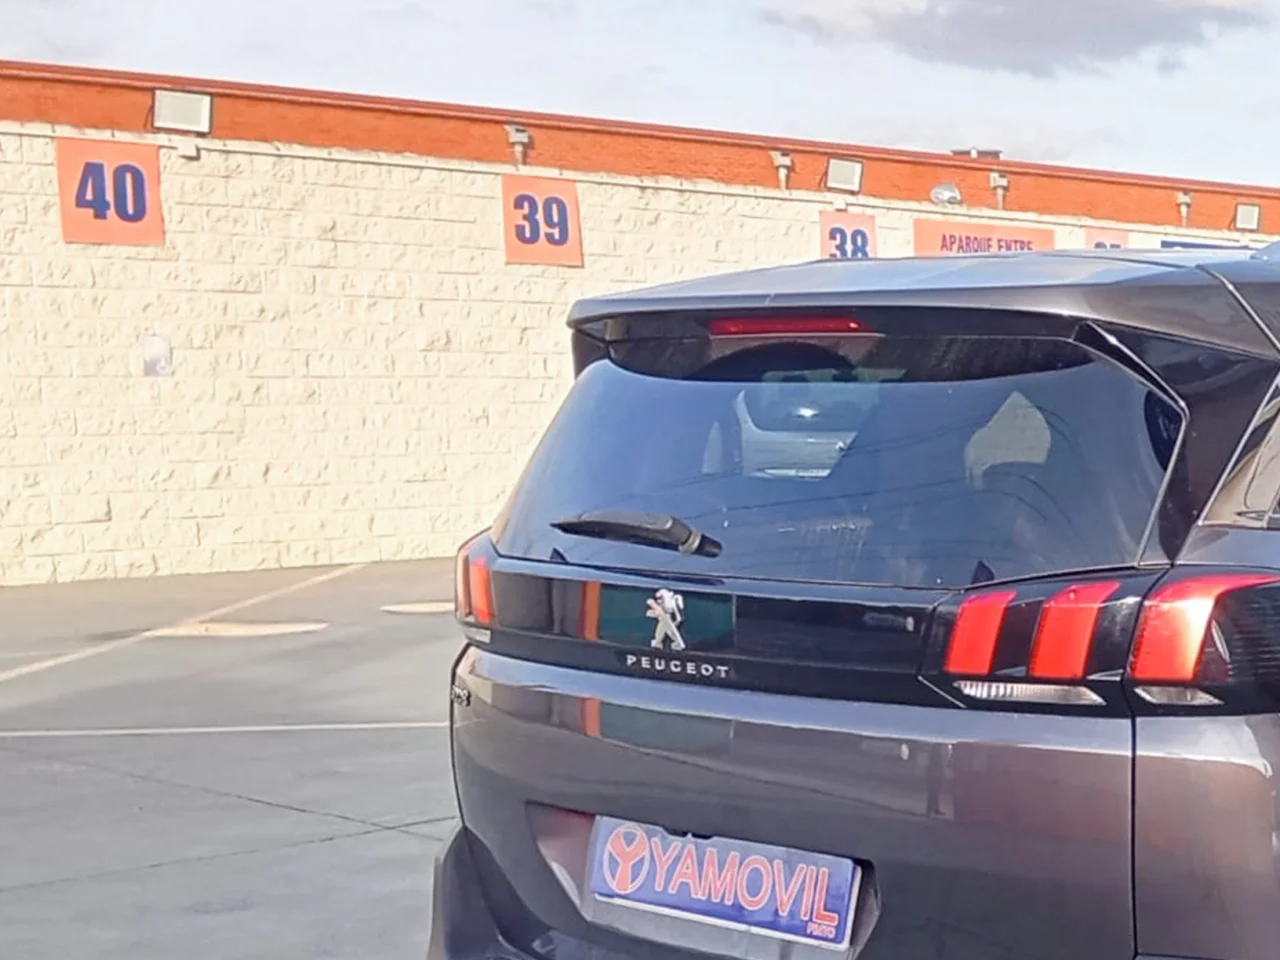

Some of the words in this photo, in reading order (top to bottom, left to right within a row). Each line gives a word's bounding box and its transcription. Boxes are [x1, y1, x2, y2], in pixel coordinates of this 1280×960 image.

[74, 161, 148, 223] 40
[513, 193, 570, 247] 39
[828, 226, 870, 259] 38
[625, 654, 730, 678] PEUGEOT
[650, 837, 839, 926] YAMOVIL
